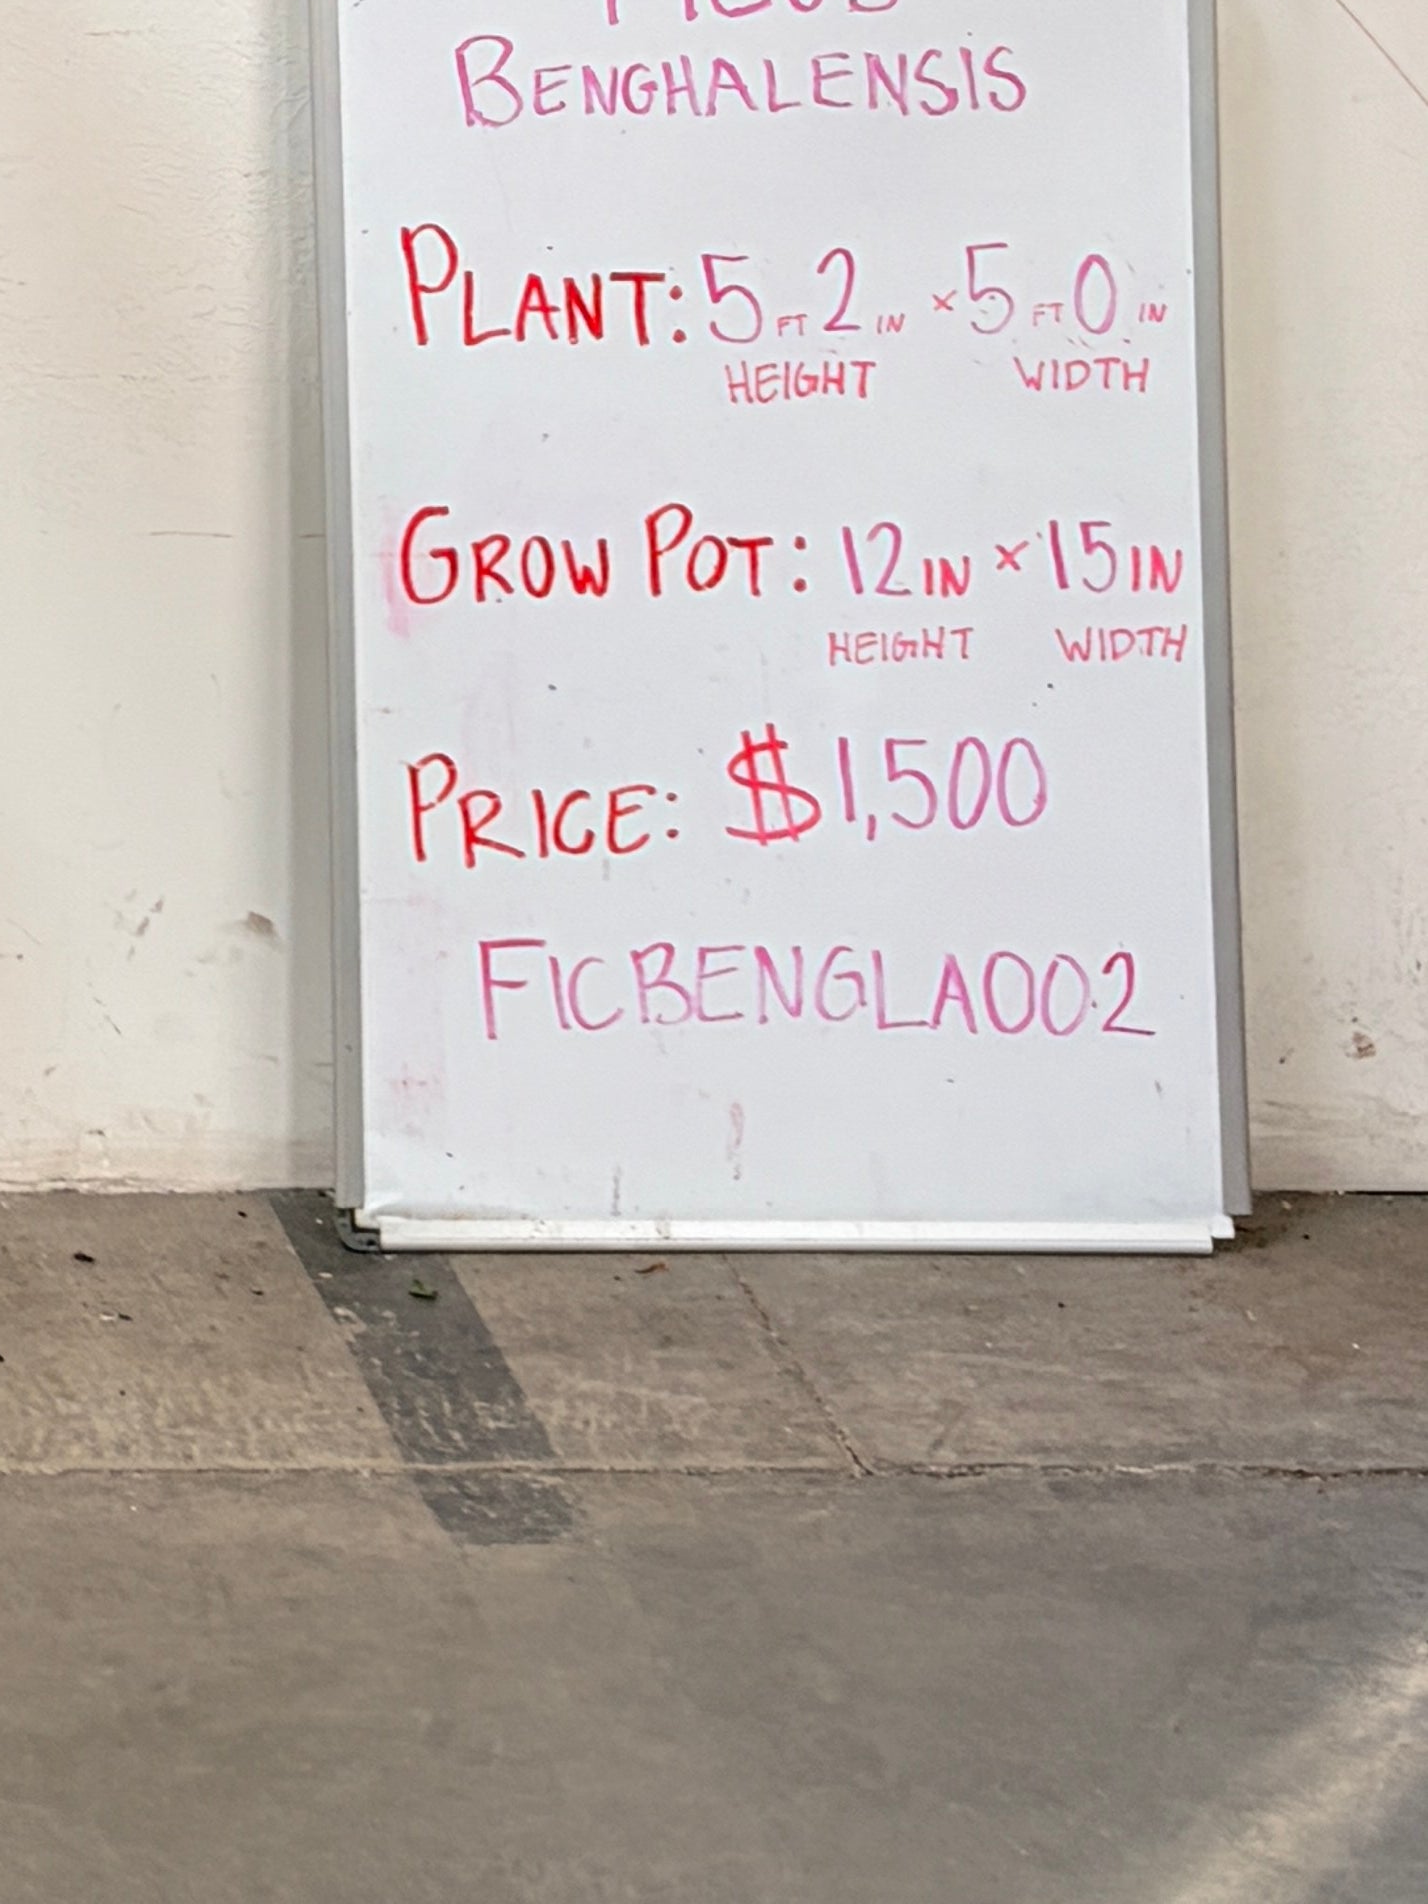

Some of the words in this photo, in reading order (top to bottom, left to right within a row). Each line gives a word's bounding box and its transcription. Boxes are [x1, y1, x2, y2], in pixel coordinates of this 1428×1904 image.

[453, 34, 1028, 129] BENGHALENSIS
[398, 222, 687, 348] PLANT:
[724, 359, 877, 405] HEIGHT
[1013, 355, 1151, 394] WIDTH
[396, 504, 612, 606] GROW
[643, 501, 808, 599] POT:
[827, 626, 974, 667] HEIGHT
[1054, 624, 1188, 664] WIDTH
[406, 751, 680, 870] PRICE:
[724, 721, 1049, 848] $1,500
[477, 937, 1157, 1042] FICBENGLA002
